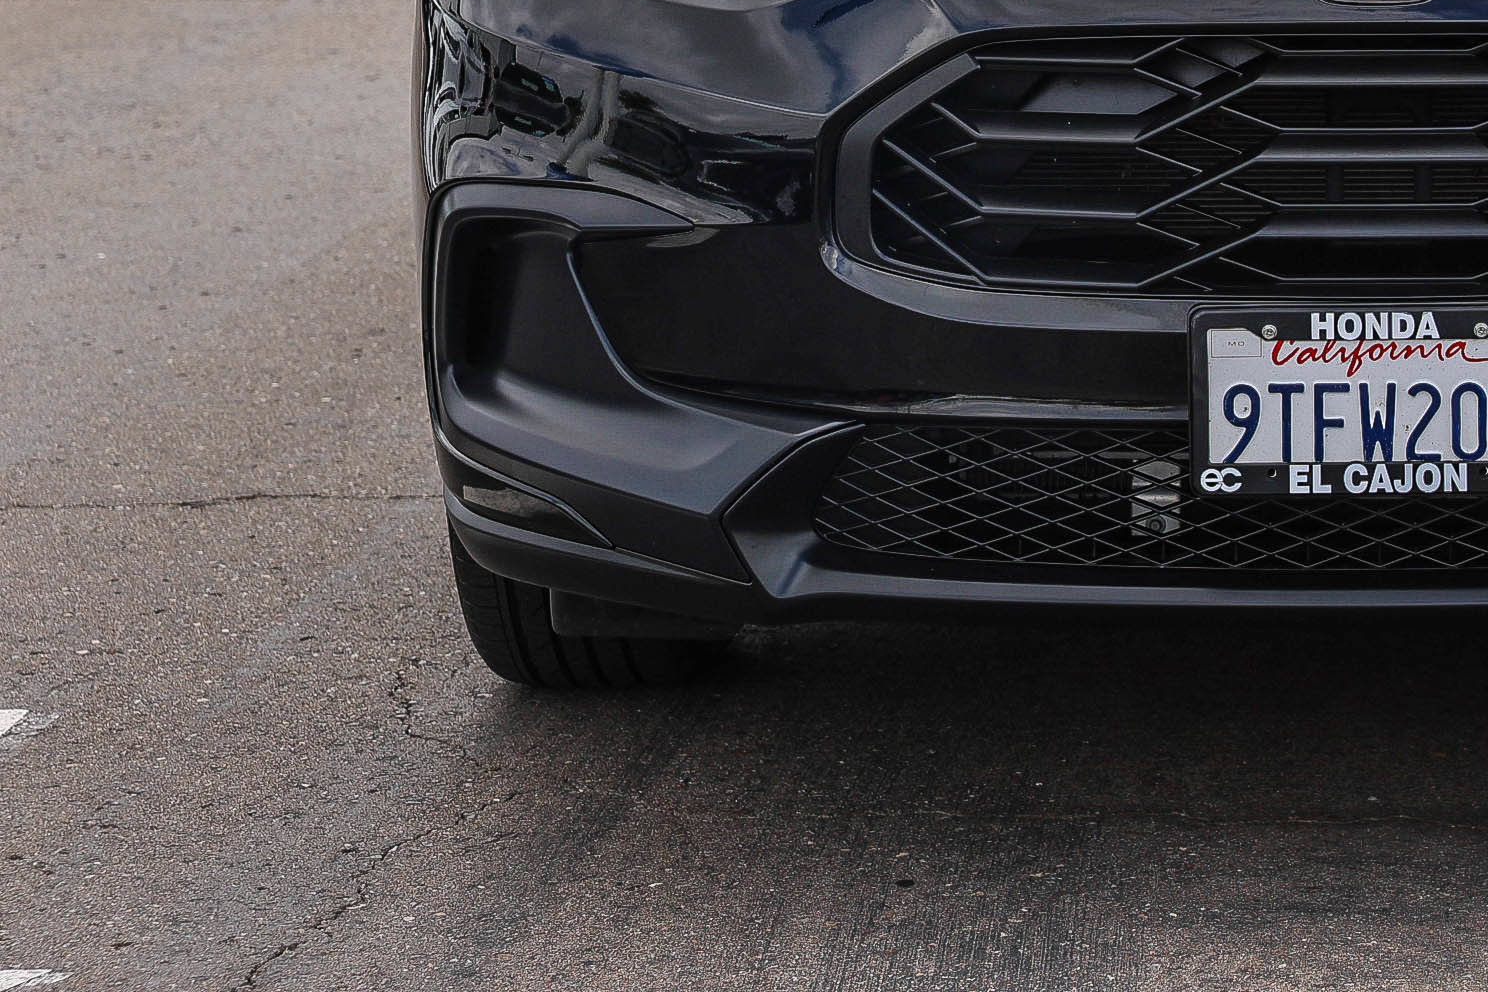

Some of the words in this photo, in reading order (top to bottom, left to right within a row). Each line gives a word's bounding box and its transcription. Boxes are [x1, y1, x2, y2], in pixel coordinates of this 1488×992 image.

[1310, 312, 1440, 340] HONDA
[1288, 464, 1332, 494] EL
[1343, 463, 1468, 494] CAJON
